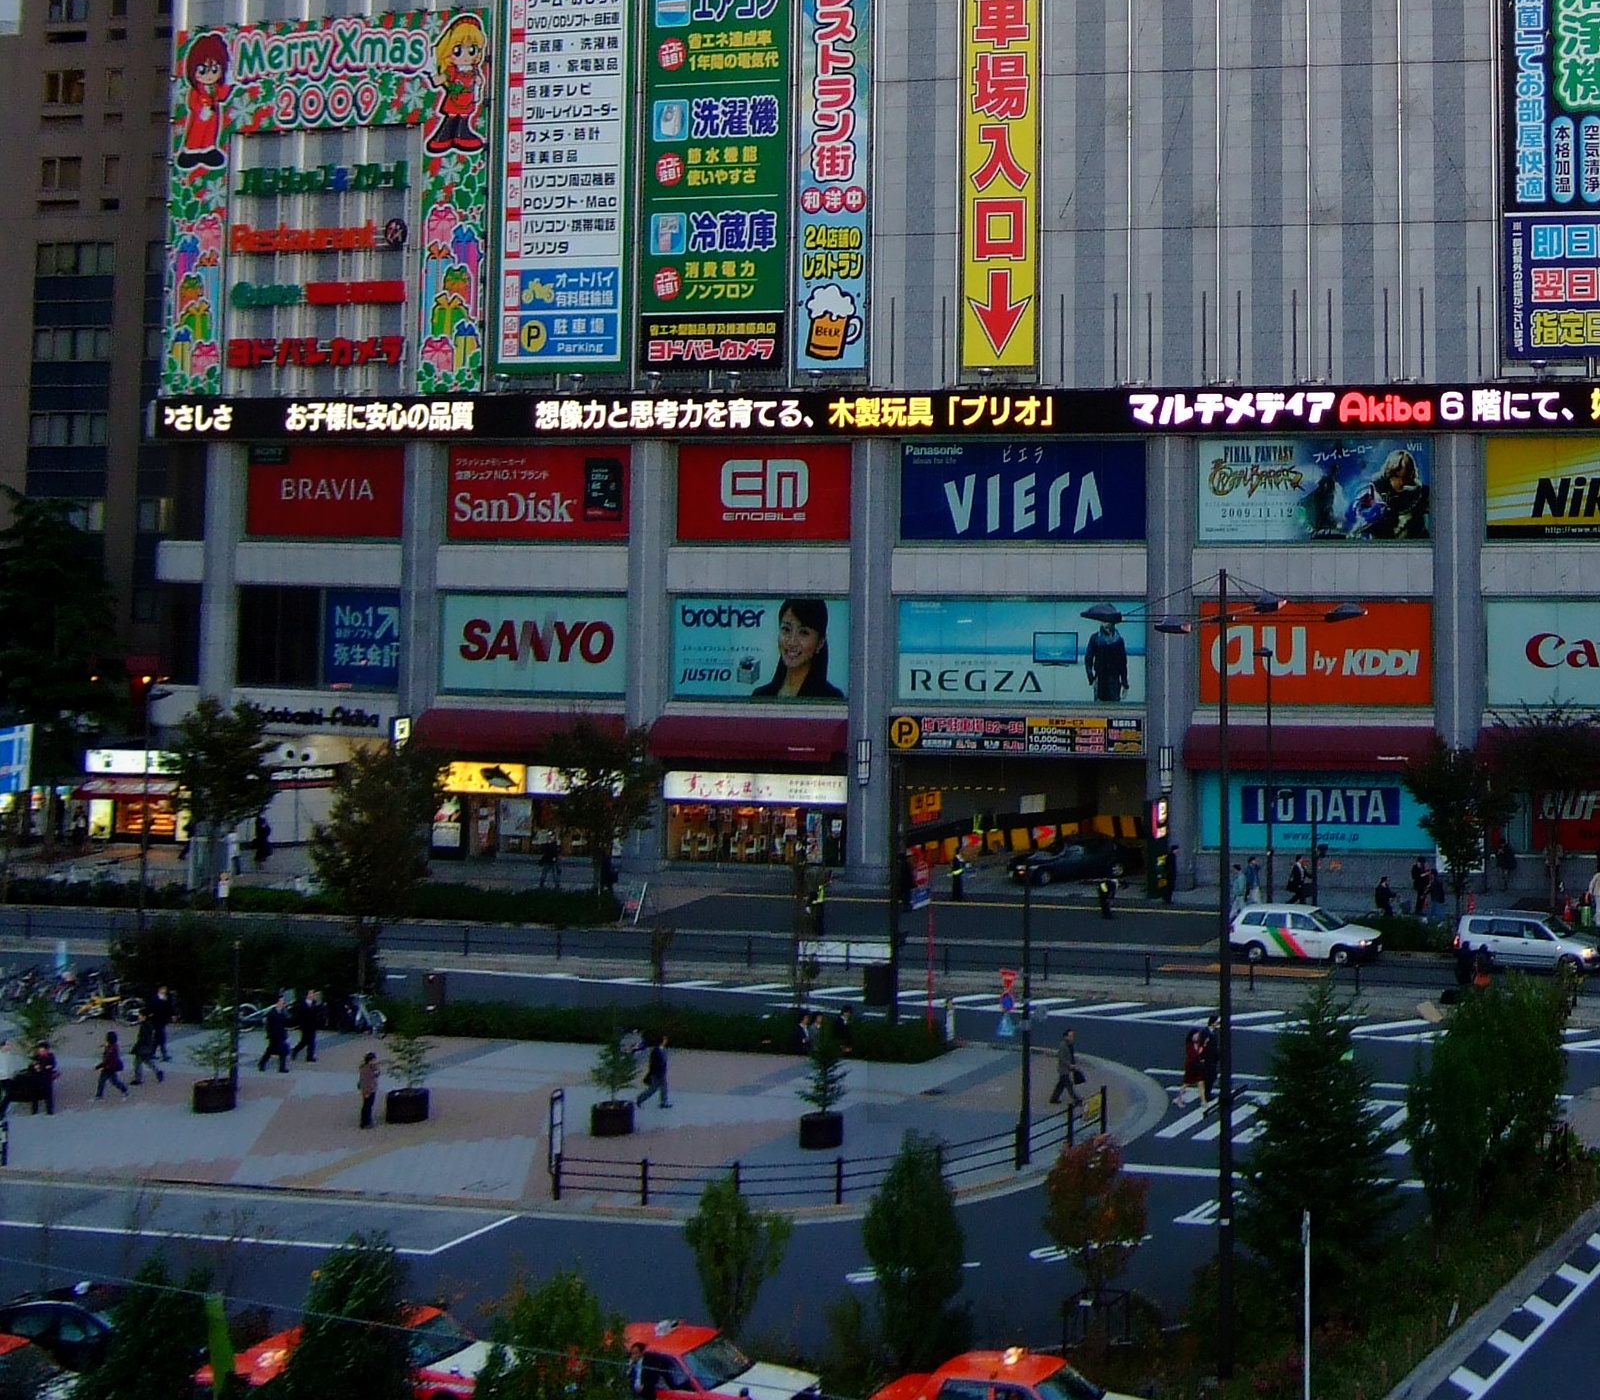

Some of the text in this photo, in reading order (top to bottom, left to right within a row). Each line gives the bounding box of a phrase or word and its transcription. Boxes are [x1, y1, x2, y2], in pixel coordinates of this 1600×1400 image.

[235, 21, 428, 81] Merry Xmas
[275, 84, 380, 123] 2009
[691, 94, 780, 139] 洗濯機
[1555, 124, 1571, 193] 本格加湿
[1584, 124, 1600, 193] 空気清浄
[689, 209, 777, 254] 冷蔵庫
[684, 260, 756, 279] 消費電力
[802, 252, 863, 279] レストラン
[555, 271, 615, 288] オートバイ
[685, 283, 755, 300] ノンフロン
[526, 325, 542, 348] P
[553, 317, 606, 336] 駐車場
[814, 324, 842, 338] BEER
[228, 335, 405, 368] ヨドバシカメラ
[556, 341, 605, 354] Parking
[648, 339, 776, 362] ヨドバシカメラ
[284, 400, 476, 432] お子様に安心の品質
[534, 399, 816, 431] 想像力と思考力を育てる、
[827, 396, 1054, 429] 木製玩具「ブリオ」
[1128, 392, 1338, 427] マルチメディア
[1338, 391, 1434, 424] Akiba
[904, 444, 965, 457] Panasonic
[1002, 445, 1044, 465] ビエラ
[1223, 445, 1295, 463] FINAL FANTASY
[1405, 442, 1424, 452] Wii
[280, 477, 376, 501] BRAVIA
[453, 491, 575, 524] SanDisk
[722, 511, 807, 523] EMOBILE
[334, 604, 375, 628] No.1
[680, 604, 766, 629] brother
[459, 618, 615, 666] SANYO
[1210, 625, 1420, 678] au by KDDI
[333, 642, 401, 669] 弥生会計
[679, 668, 733, 685] JUSTIO
[909, 668, 1043, 693] REGZA
[1305, 787, 1388, 823] DATA
